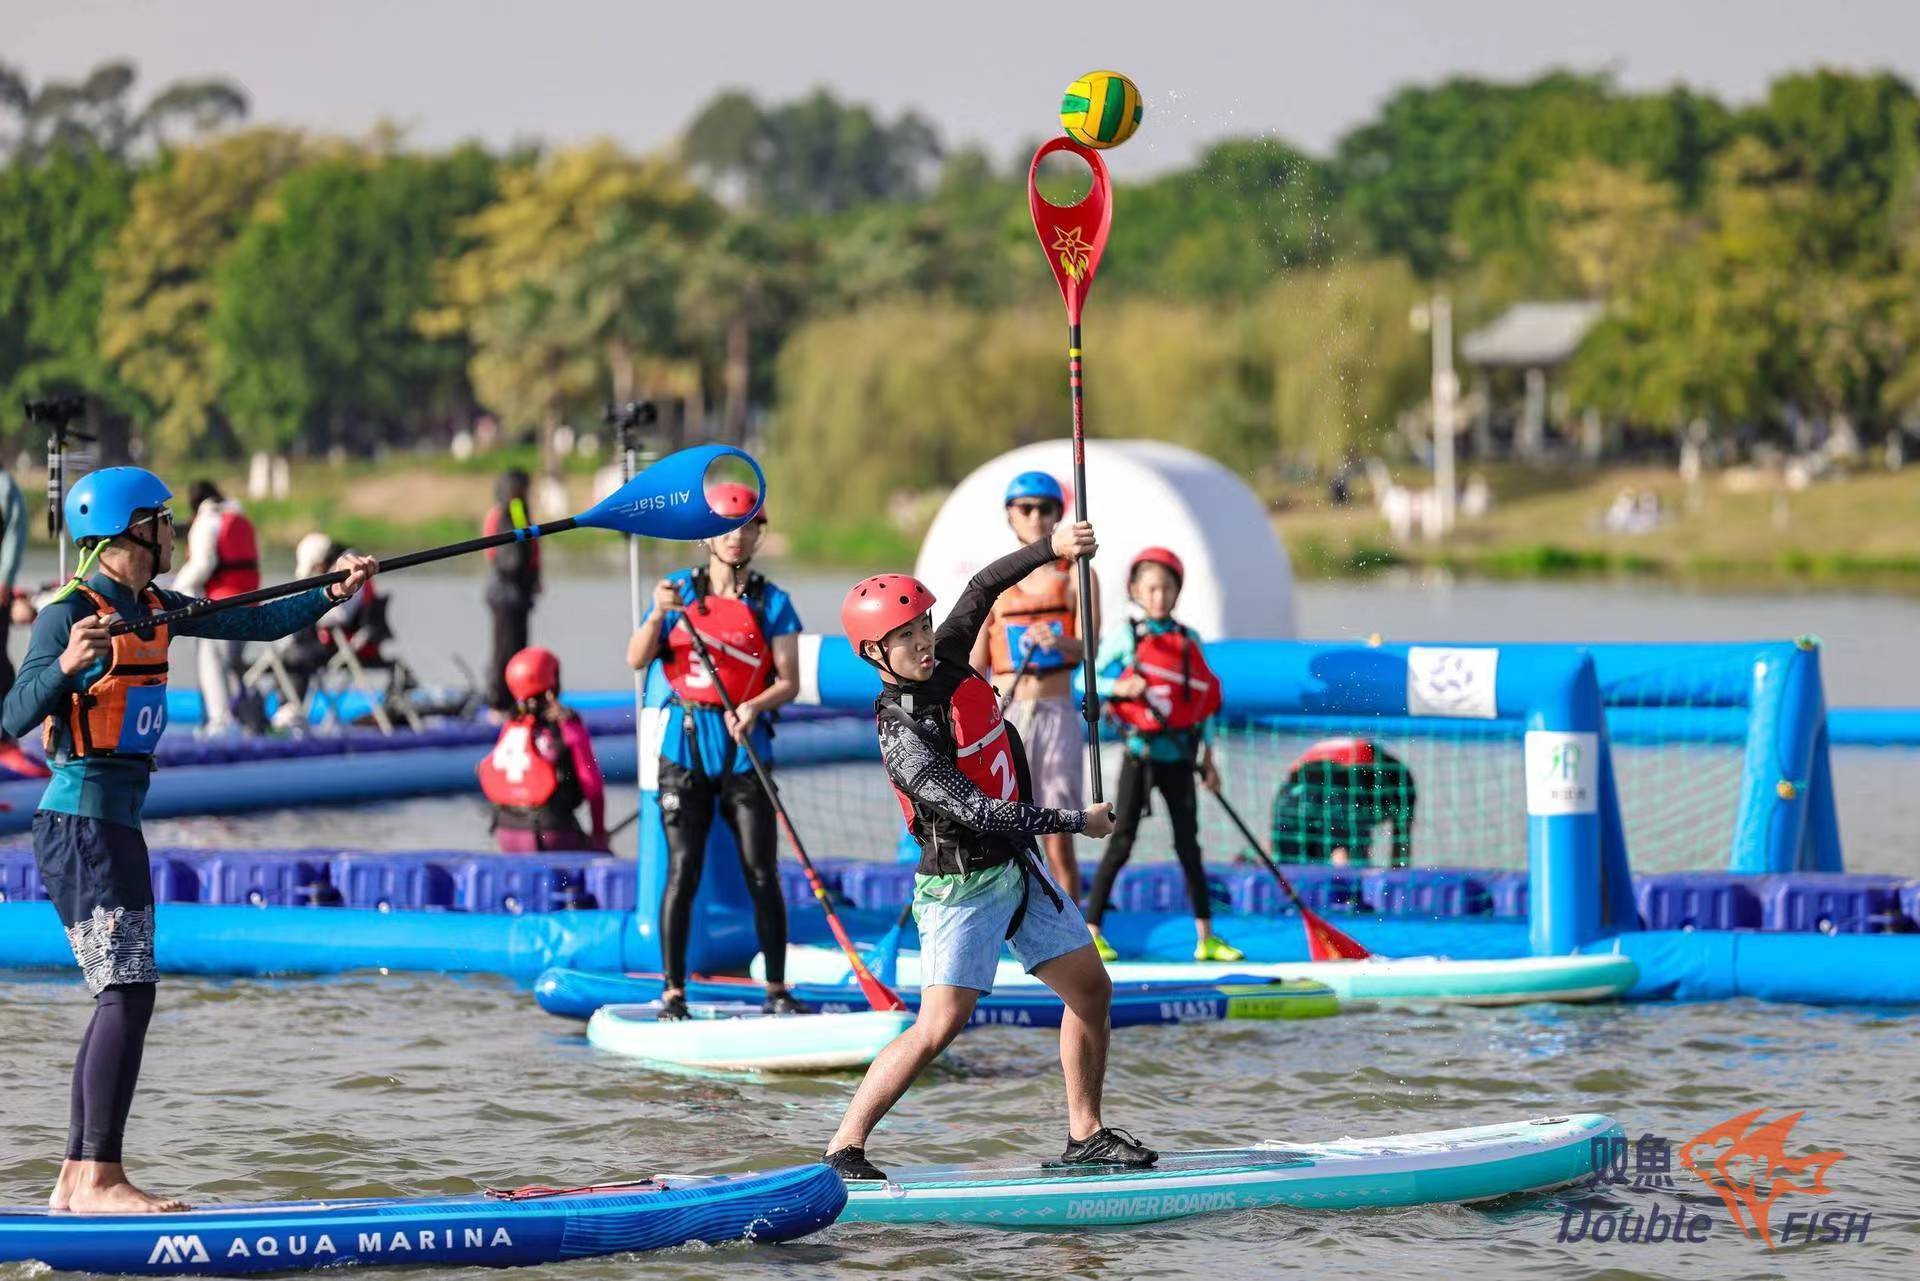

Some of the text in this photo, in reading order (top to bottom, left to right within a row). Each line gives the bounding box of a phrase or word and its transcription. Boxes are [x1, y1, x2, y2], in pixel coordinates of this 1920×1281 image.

[633, 489, 691, 511] All Star
[136, 704, 163, 736] 04
[492, 726, 531, 782] 4
[990, 750, 1016, 800] 2
[968, 1008, 1032, 1025] RINA
[1161, 1190, 1237, 1217] BOARDS
[227, 1234, 337, 1258] AQUA
[358, 1227, 513, 1252] MARINA
